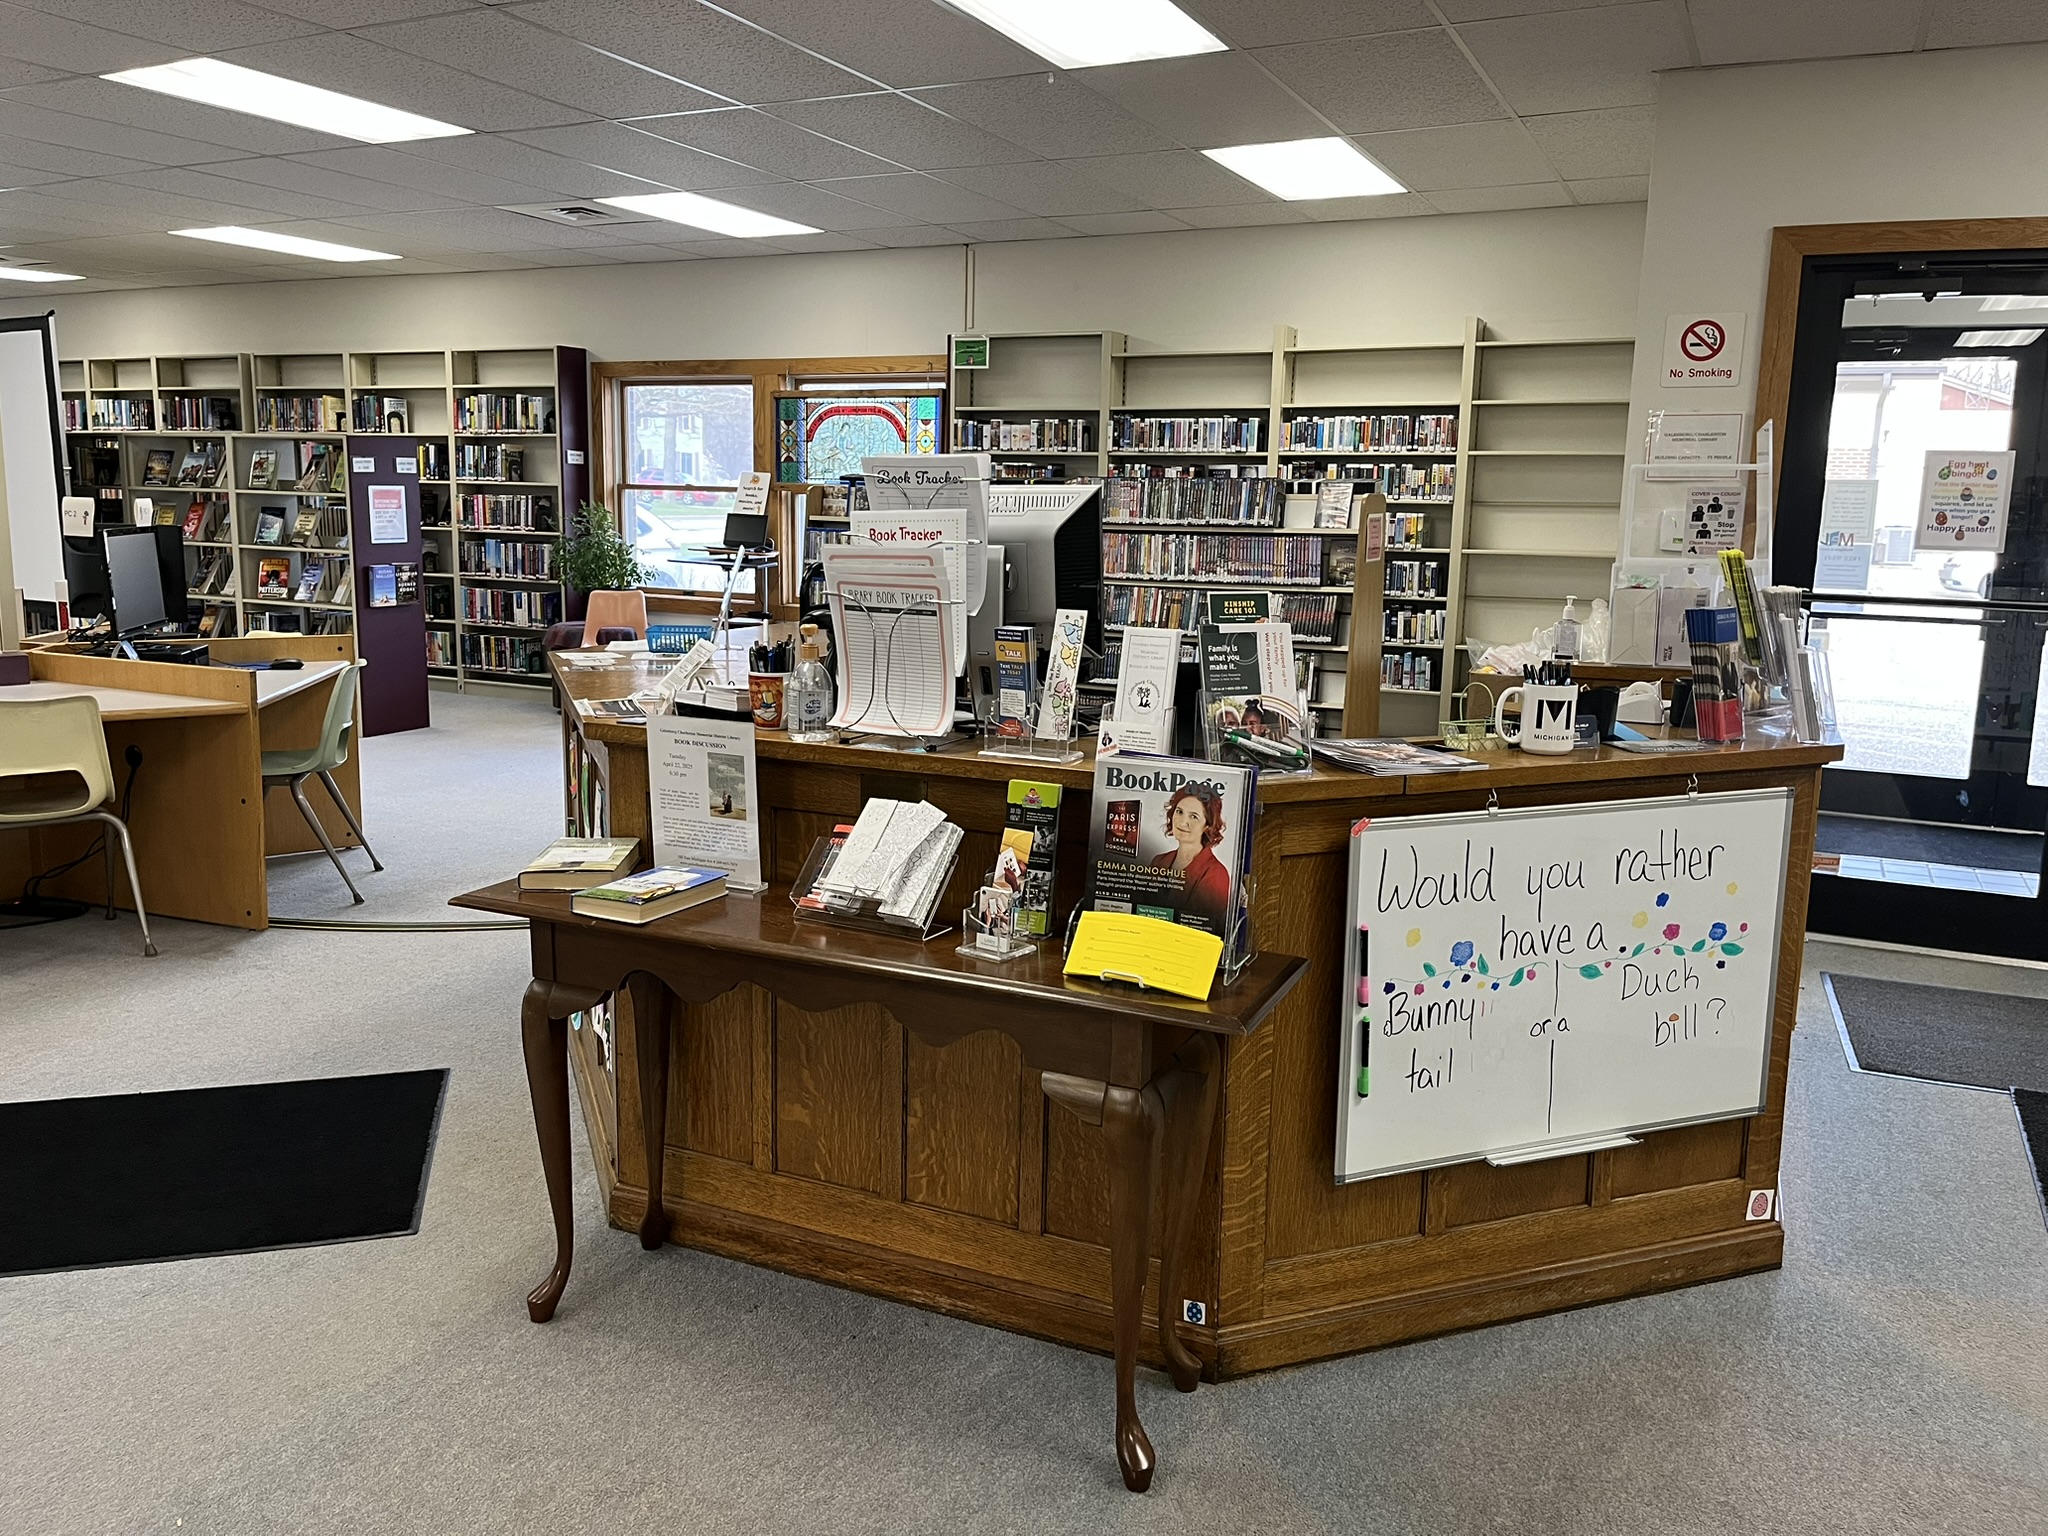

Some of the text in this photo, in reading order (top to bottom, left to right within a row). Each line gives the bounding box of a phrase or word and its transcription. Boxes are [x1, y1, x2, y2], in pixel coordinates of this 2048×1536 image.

[1669, 368, 1732, 378] No Smoking
[1948, 460, 1967, 469] Egg
[876, 469, 964, 486] Book Tracker
[869, 526, 942, 542] Book Tracker
[1926, 524, 1996, 534] Happy Easter!!
[843, 589, 935, 607] LIBRARY BOOK TRACKER
[1208, 644, 1230, 653] Family
[1536, 700, 1572, 730] M
[692, 740, 727, 749] DISCUSSION
[1106, 766, 1226, 802] BookPage
[1109, 813, 1136, 822] PARIS
[1107, 823, 1136, 832] EXPRESS
[1105, 844, 1135, 854] DONOGHUE
[1097, 860, 1186, 879] EMMA DONOGHUE
[1378, 829, 1725, 922] Would you rather
[1500, 914, 1608, 962] have a
[1620, 959, 1700, 1001] Duck
[1387, 992, 1476, 1040] Bunny
[1530, 1018, 1570, 1038] or a
[1404, 1047, 1453, 1093] tail
